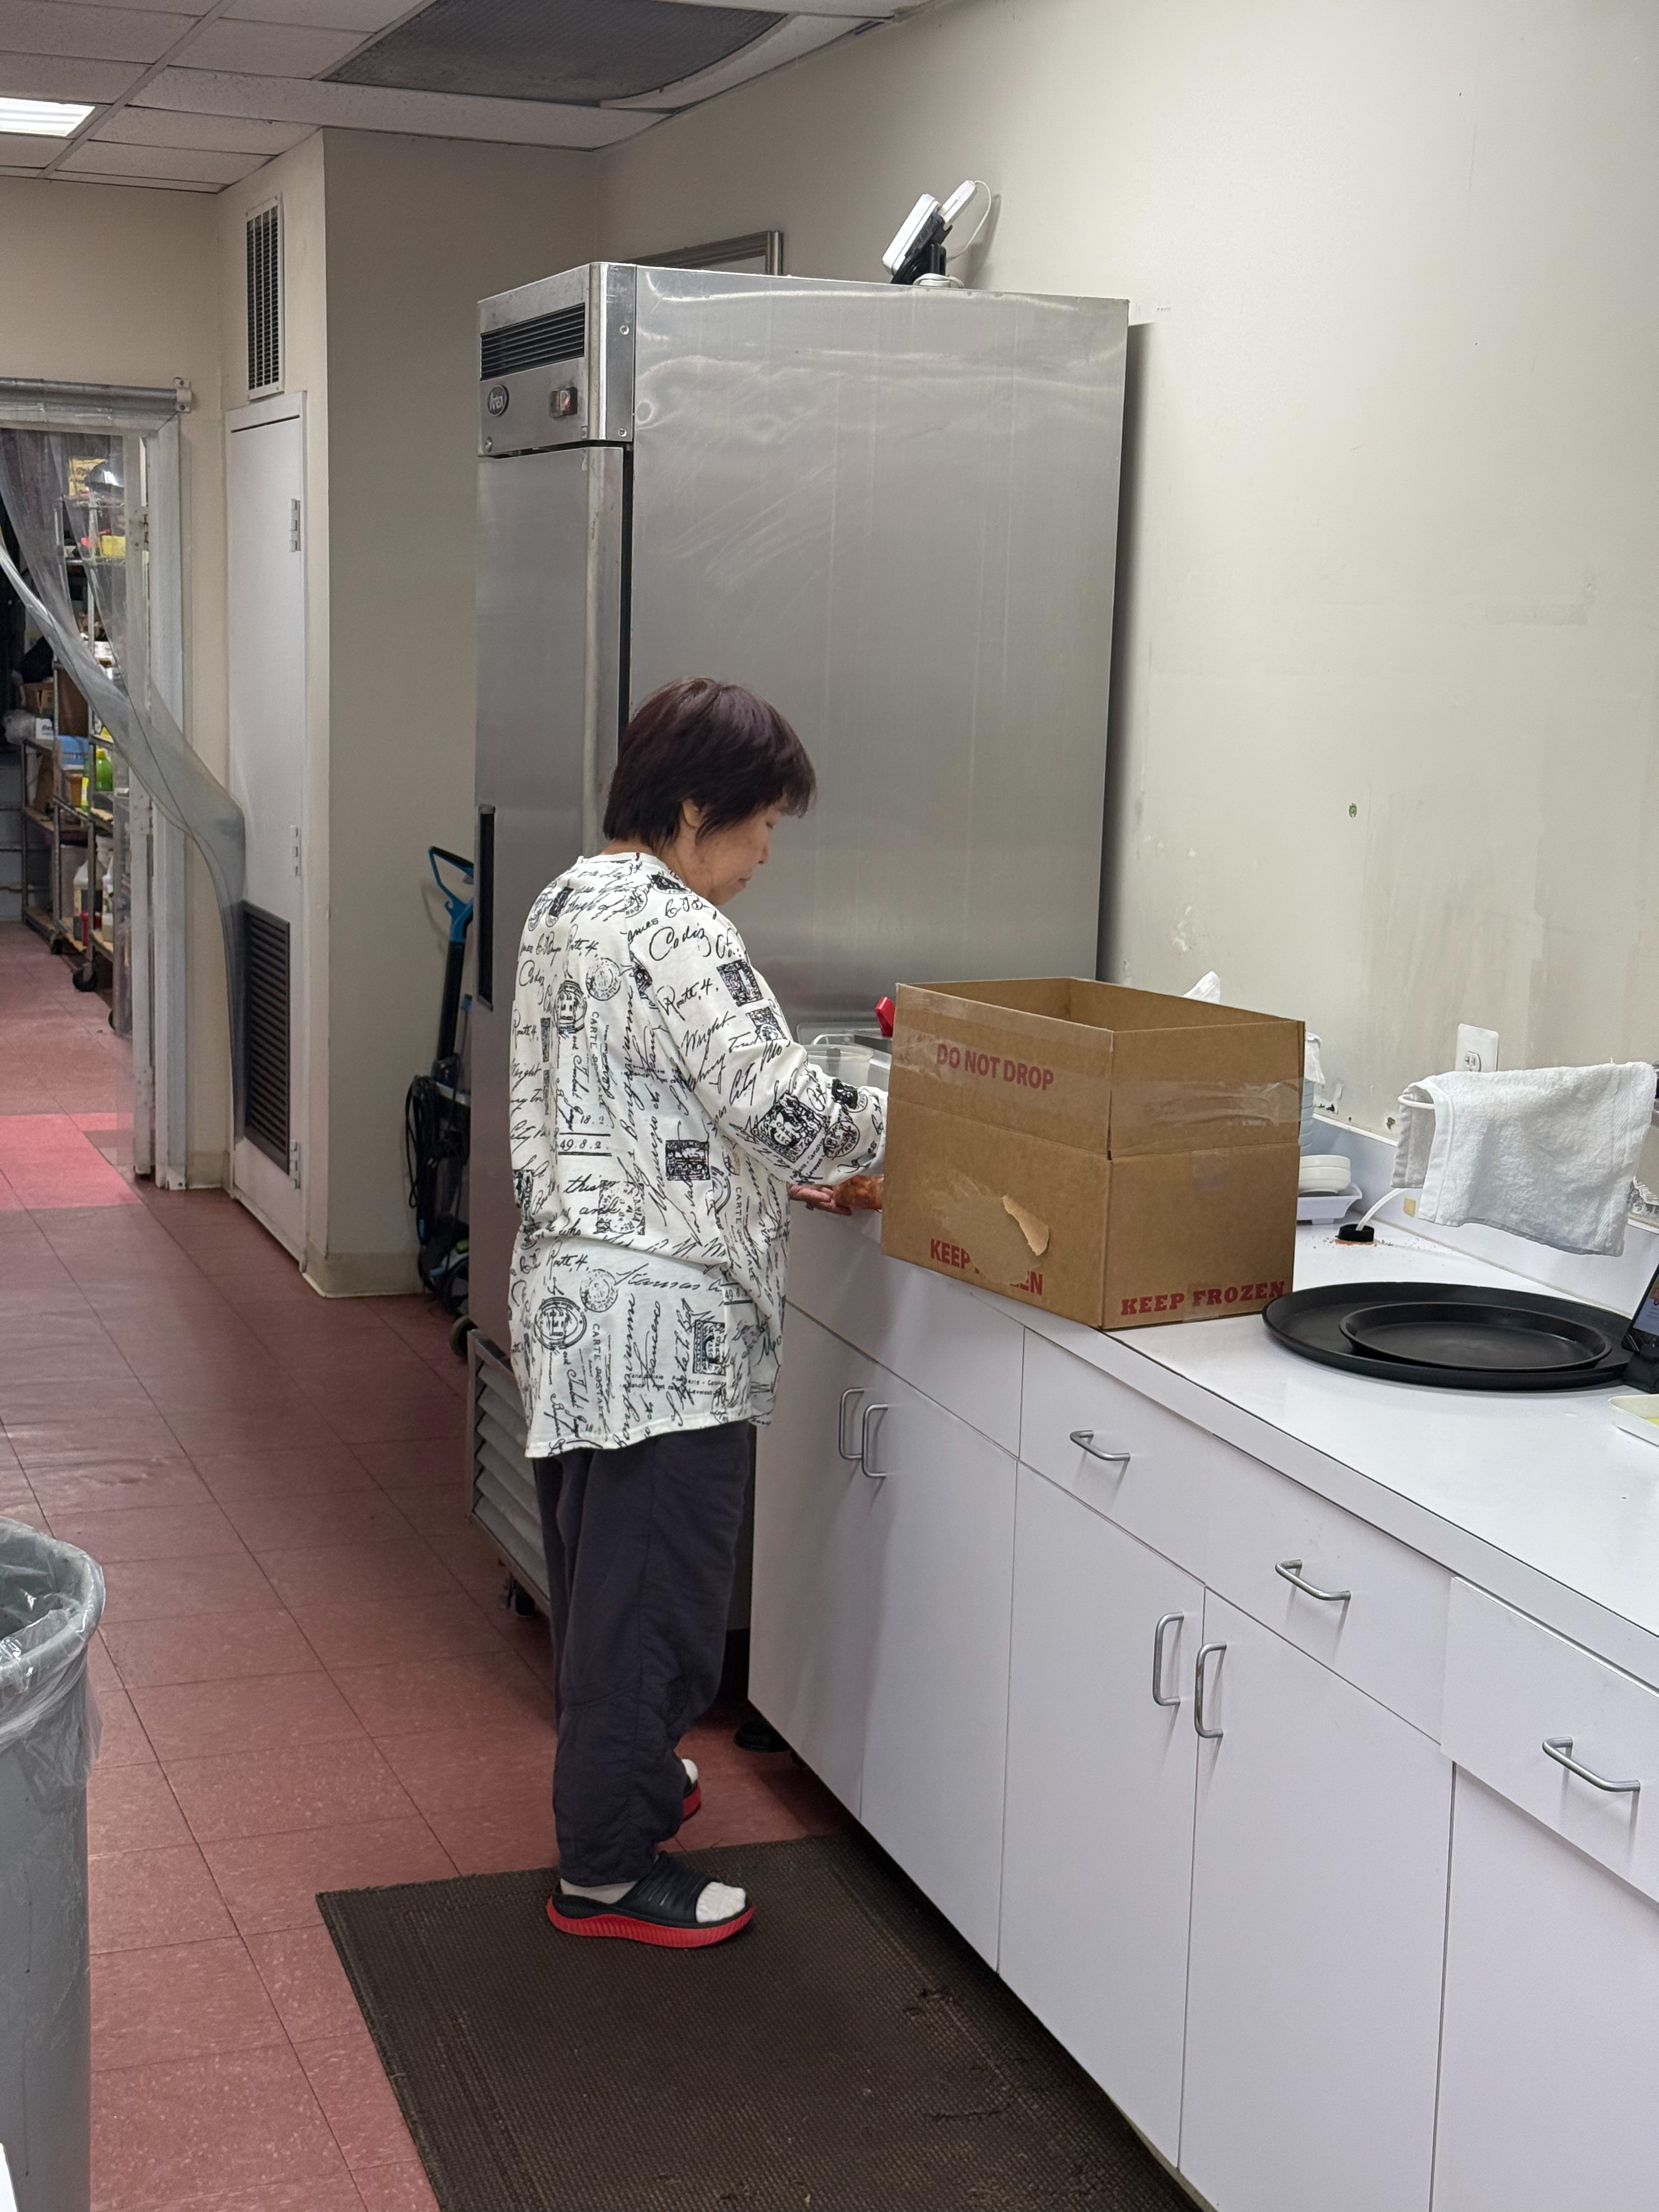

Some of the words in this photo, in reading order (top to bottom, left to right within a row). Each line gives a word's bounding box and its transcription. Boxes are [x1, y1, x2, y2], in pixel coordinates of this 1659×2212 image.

[936, 1043, 960, 1069] DO
[964, 1050, 1000, 1078] NOT
[1003, 1059, 1054, 1091] DROP
[930, 1238, 970, 1269] KEEP
[1121, 1293, 1185, 1316] KEEP
[1192, 1280, 1285, 1307] FROZEN
[592, 1323, 602, 1362] CARTE
